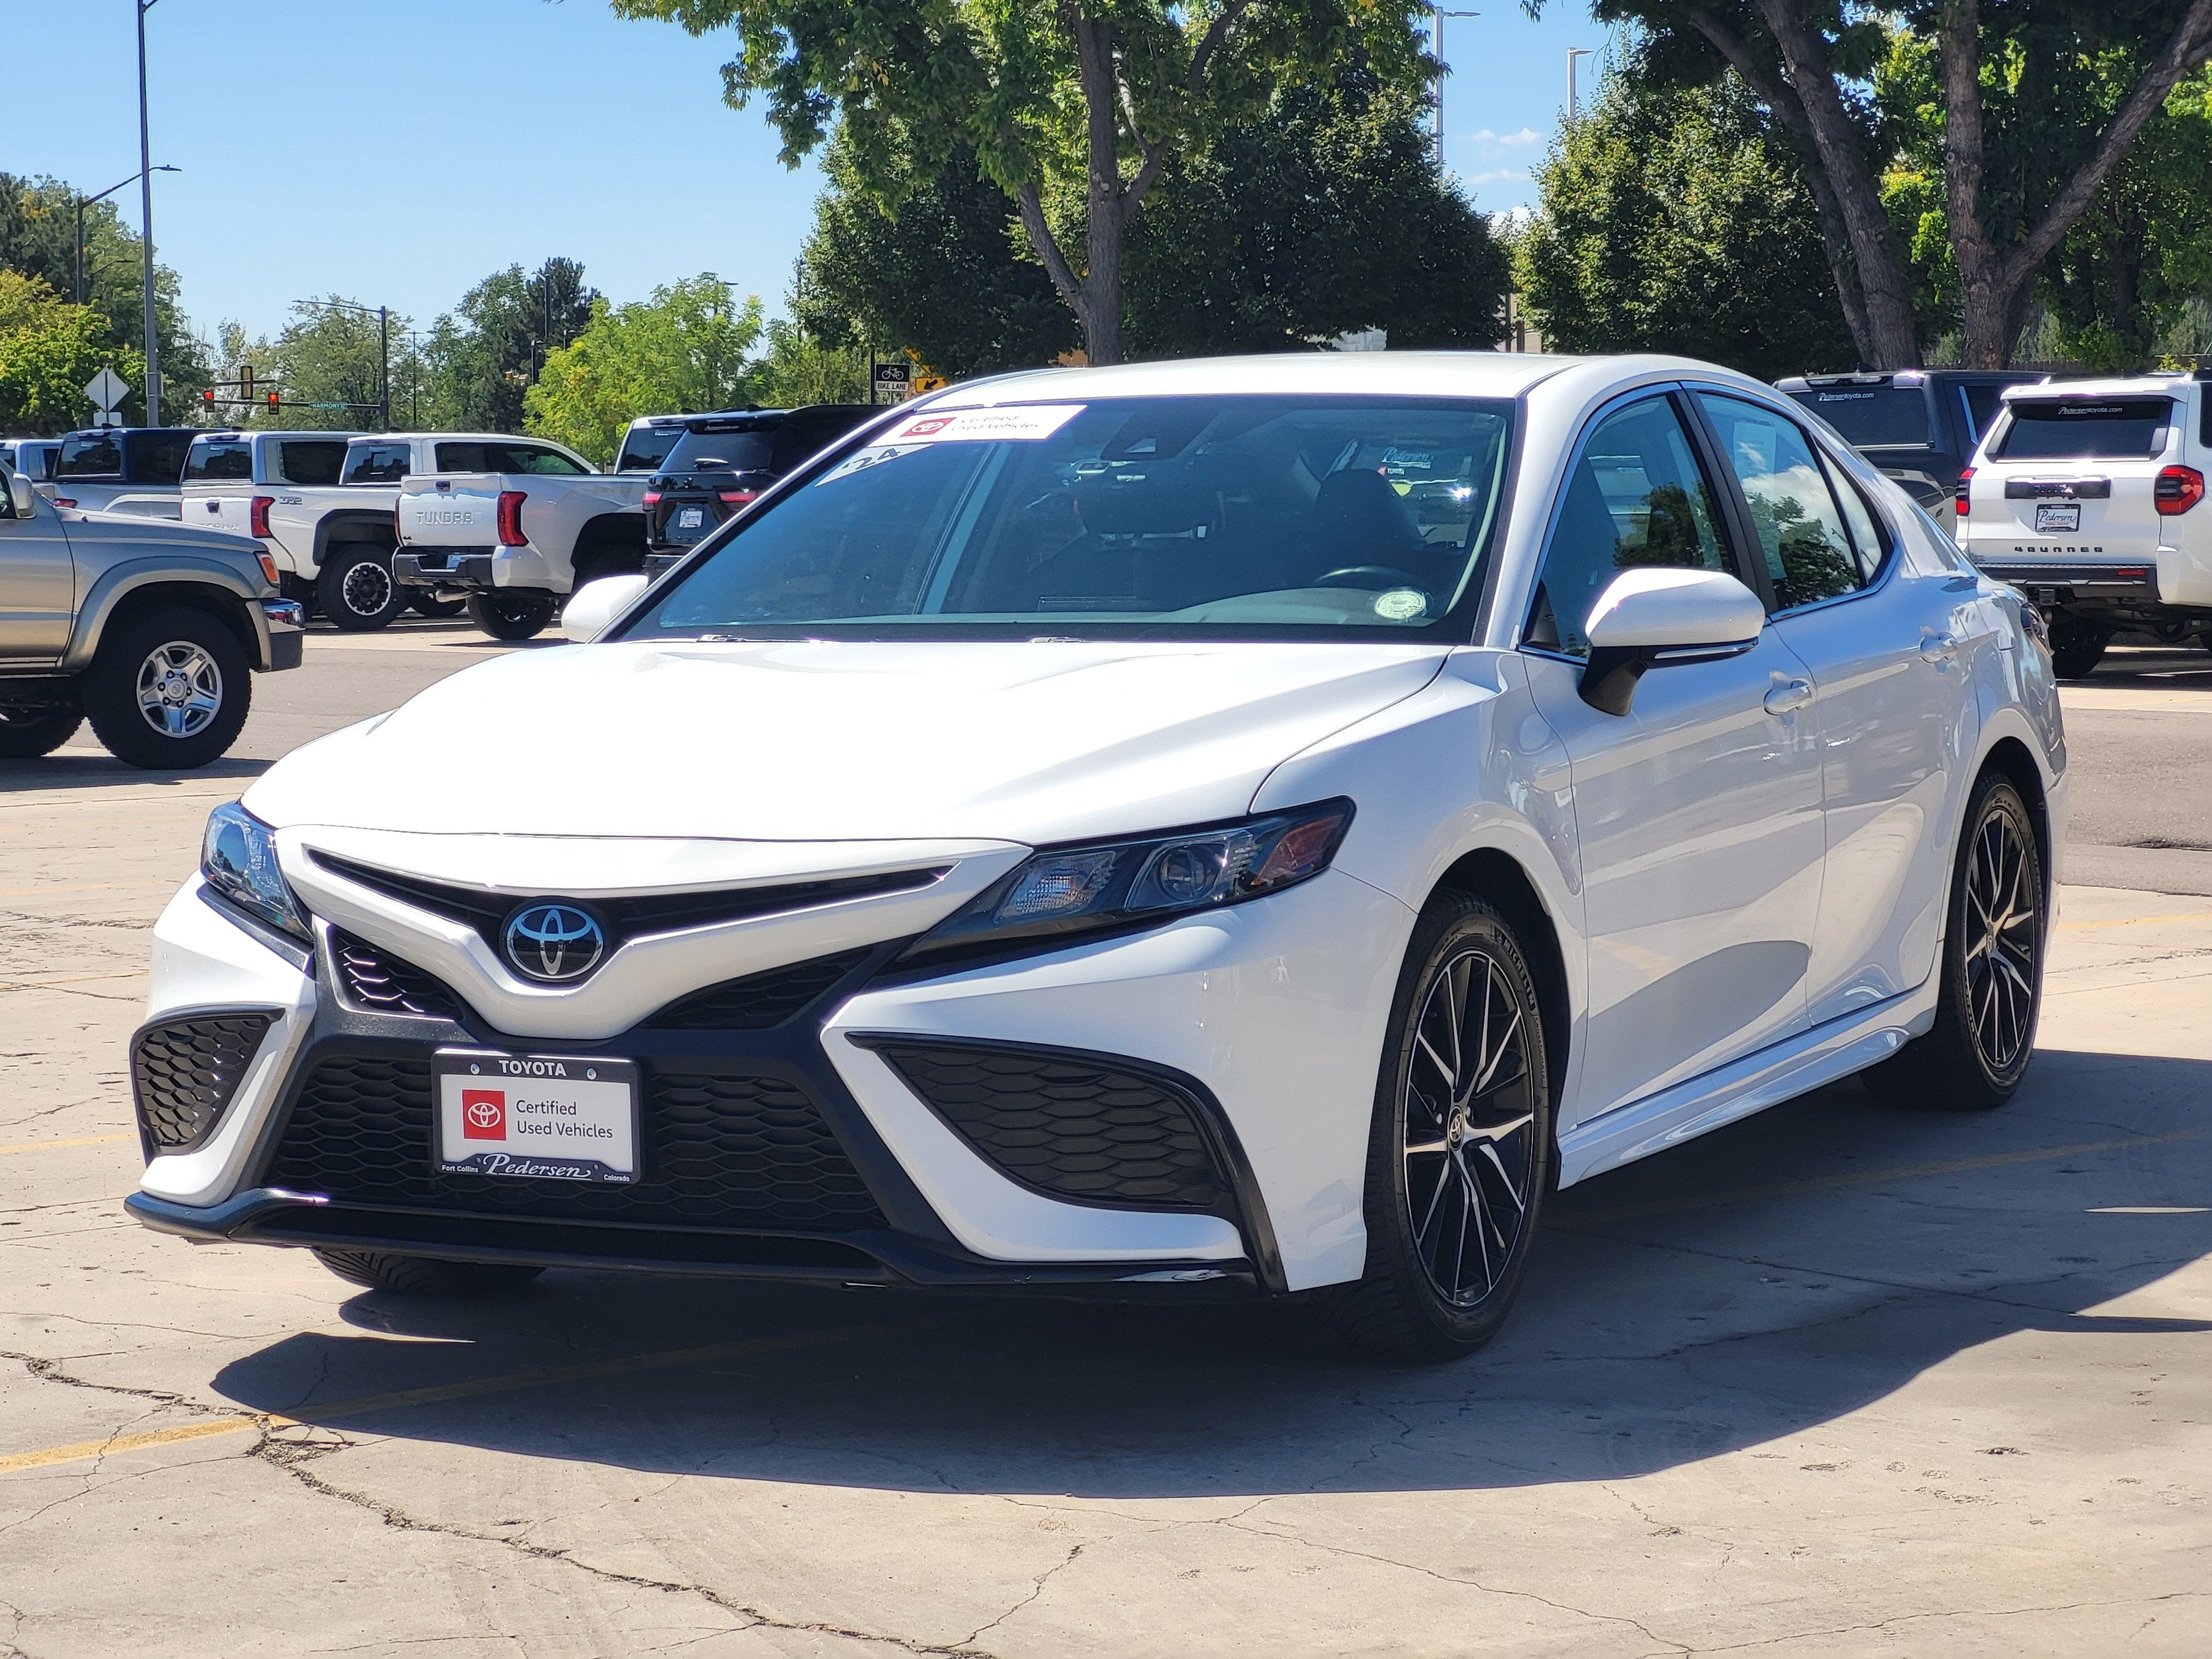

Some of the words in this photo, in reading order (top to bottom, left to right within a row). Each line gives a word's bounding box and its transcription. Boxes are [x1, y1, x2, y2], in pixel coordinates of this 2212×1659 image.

[416, 512, 473, 524] TUNDRA
[2038, 510, 2077, 523] Pedersen
[1503, 937, 1535, 1006] MICHELIN
[498, 1060, 567, 1077] TOYOTA
[516, 1099, 577, 1115] Certified
[517, 1120, 552, 1135] Used
[555, 1122, 613, 1139] Vehicles
[457, 1165, 479, 1173] Collins
[483, 1154, 592, 1178] Pedersen
[603, 1174, 630, 1182] Colorado
